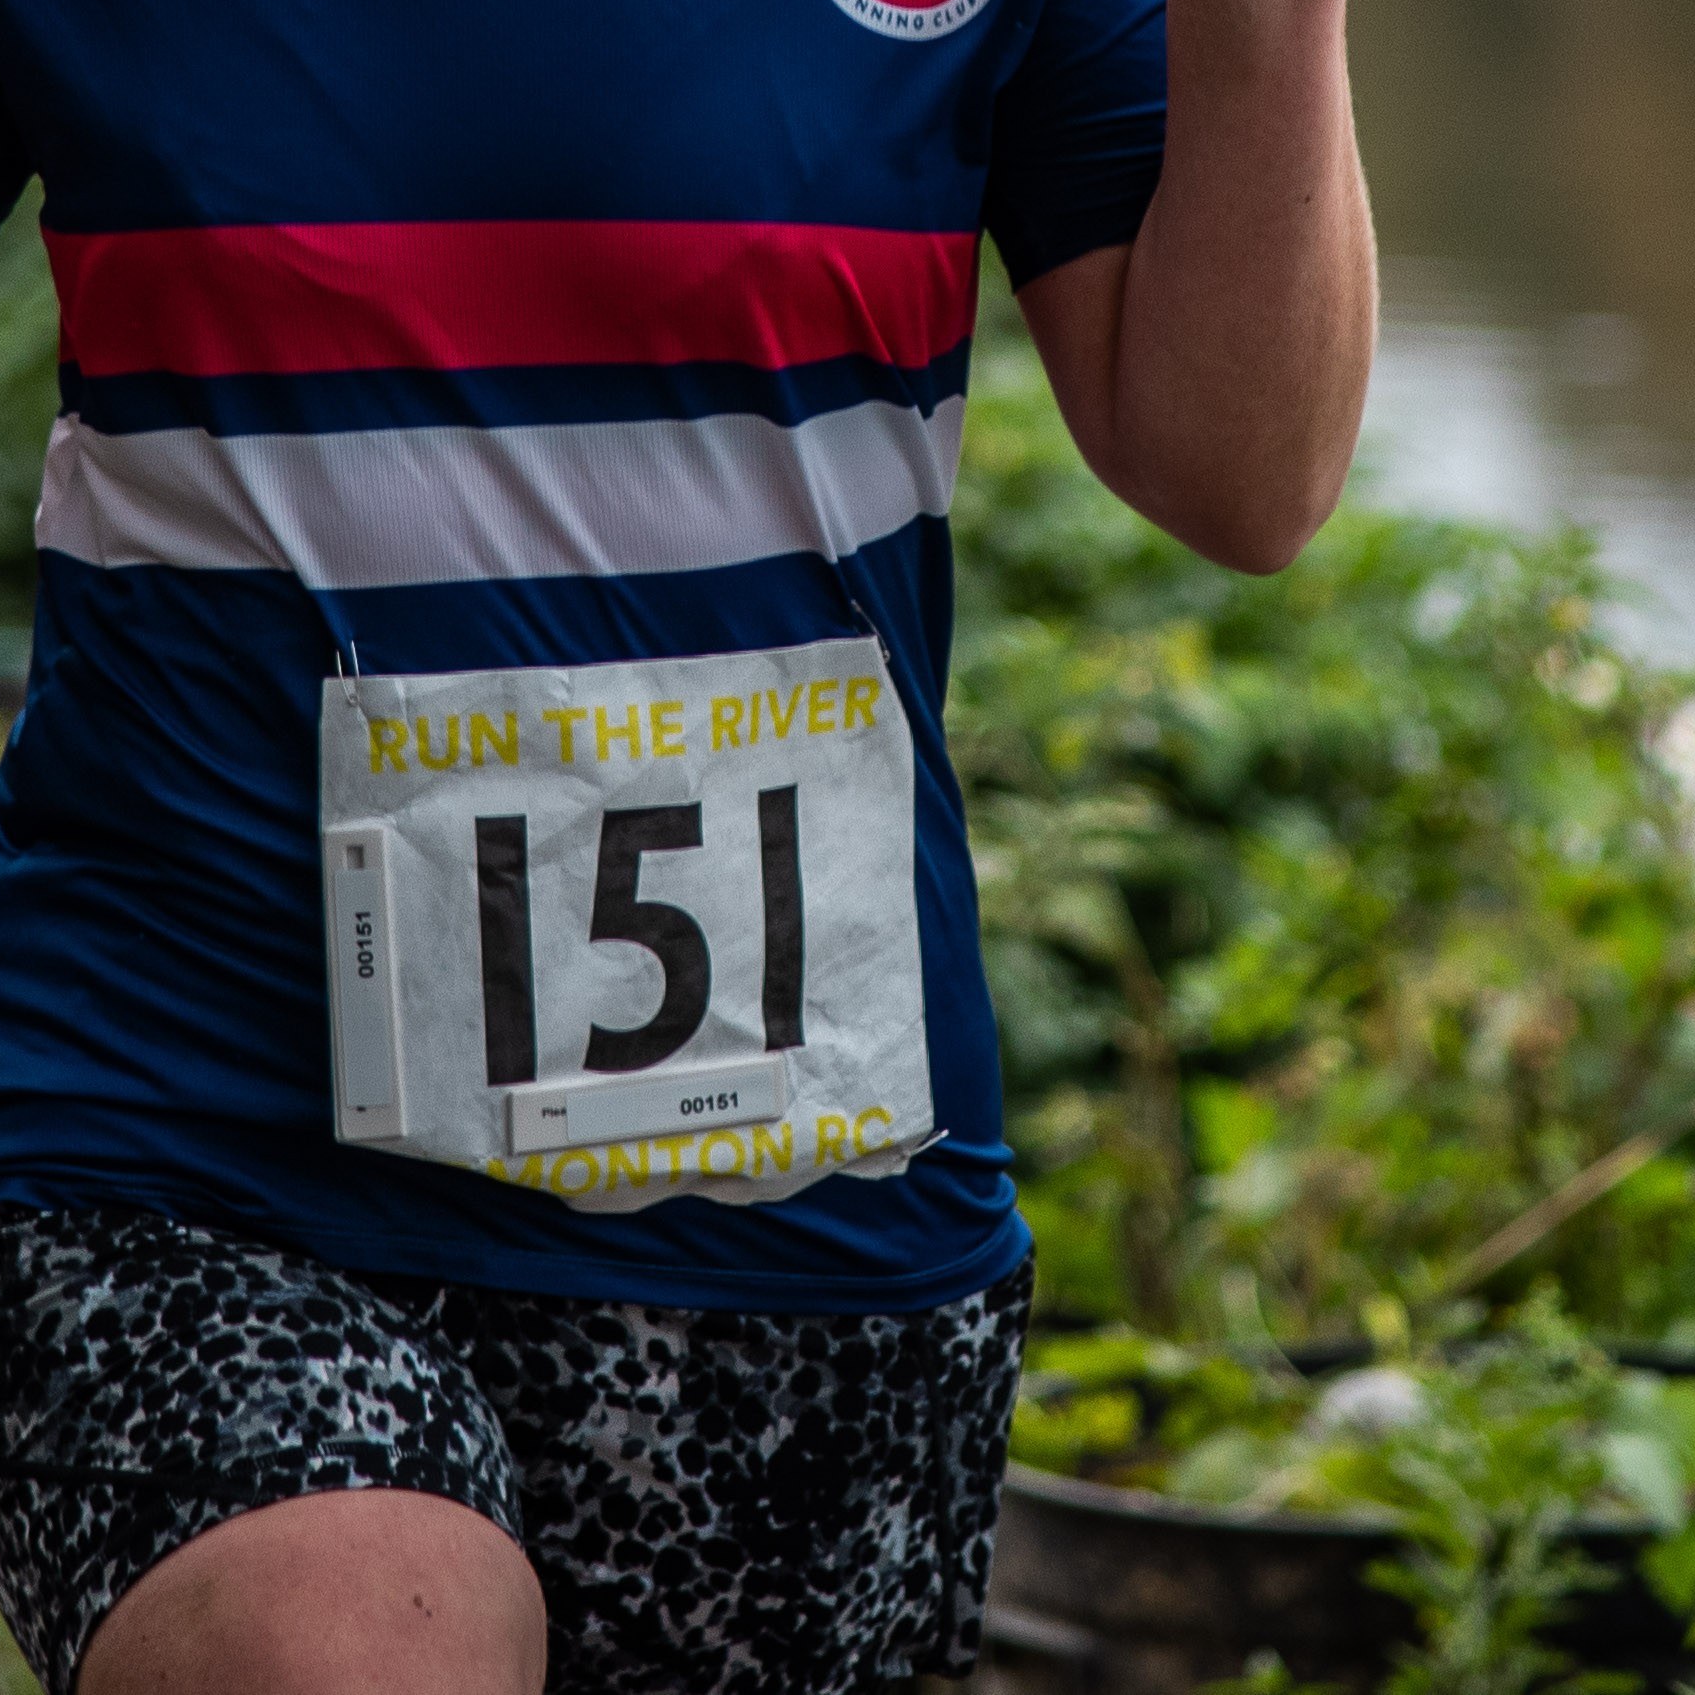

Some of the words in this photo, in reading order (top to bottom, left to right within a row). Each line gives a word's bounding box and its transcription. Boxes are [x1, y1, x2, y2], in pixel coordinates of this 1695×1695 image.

[368, 711, 519, 774] RUN
[542, 700, 686, 764] THE
[710, 676, 881, 752] RIVER
[355, 910, 374, 979] 00151
[474, 783, 806, 1088] 151
[680, 1091, 740, 1116] 00151
[446, 1123, 792, 1197] MONTON
[814, 1106, 894, 1168] RC
